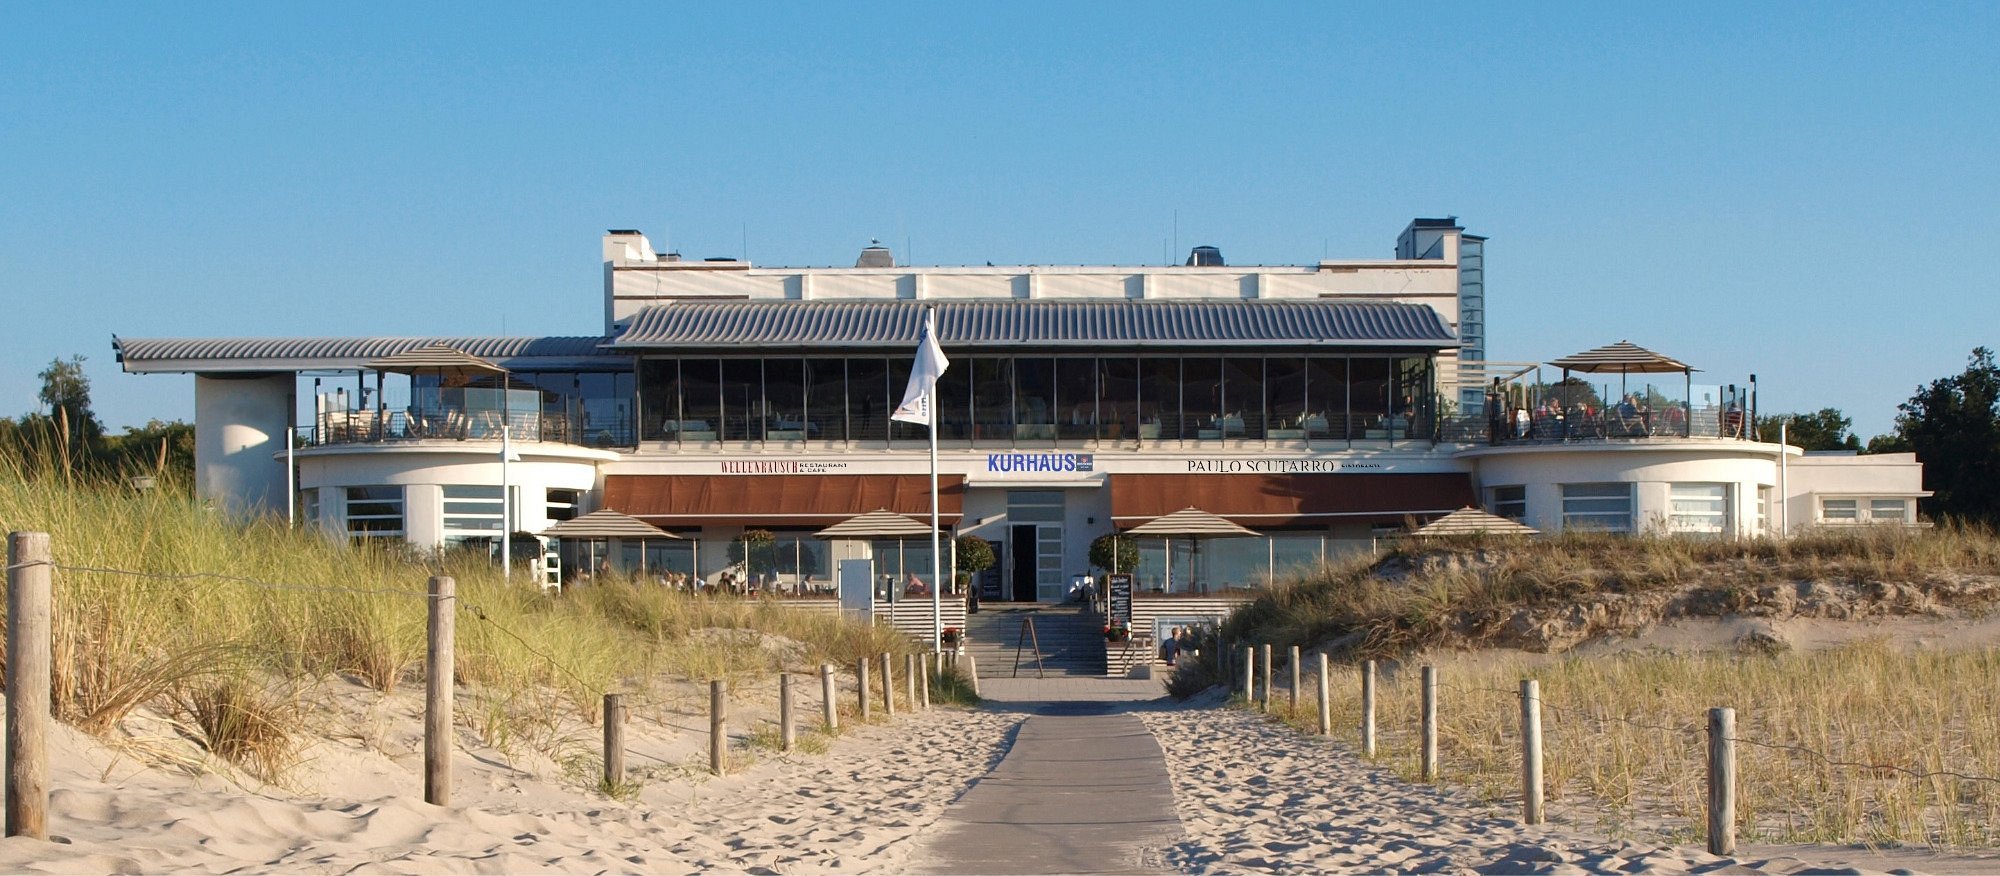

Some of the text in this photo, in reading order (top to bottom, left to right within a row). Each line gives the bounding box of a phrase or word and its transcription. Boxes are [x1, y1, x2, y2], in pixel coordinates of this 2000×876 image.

[721, 460, 798, 473] WELLENRAUSCH
[988, 453, 1075, 472] KURHAUS
[1187, 460, 1335, 473] PAULO SCUTARRO
